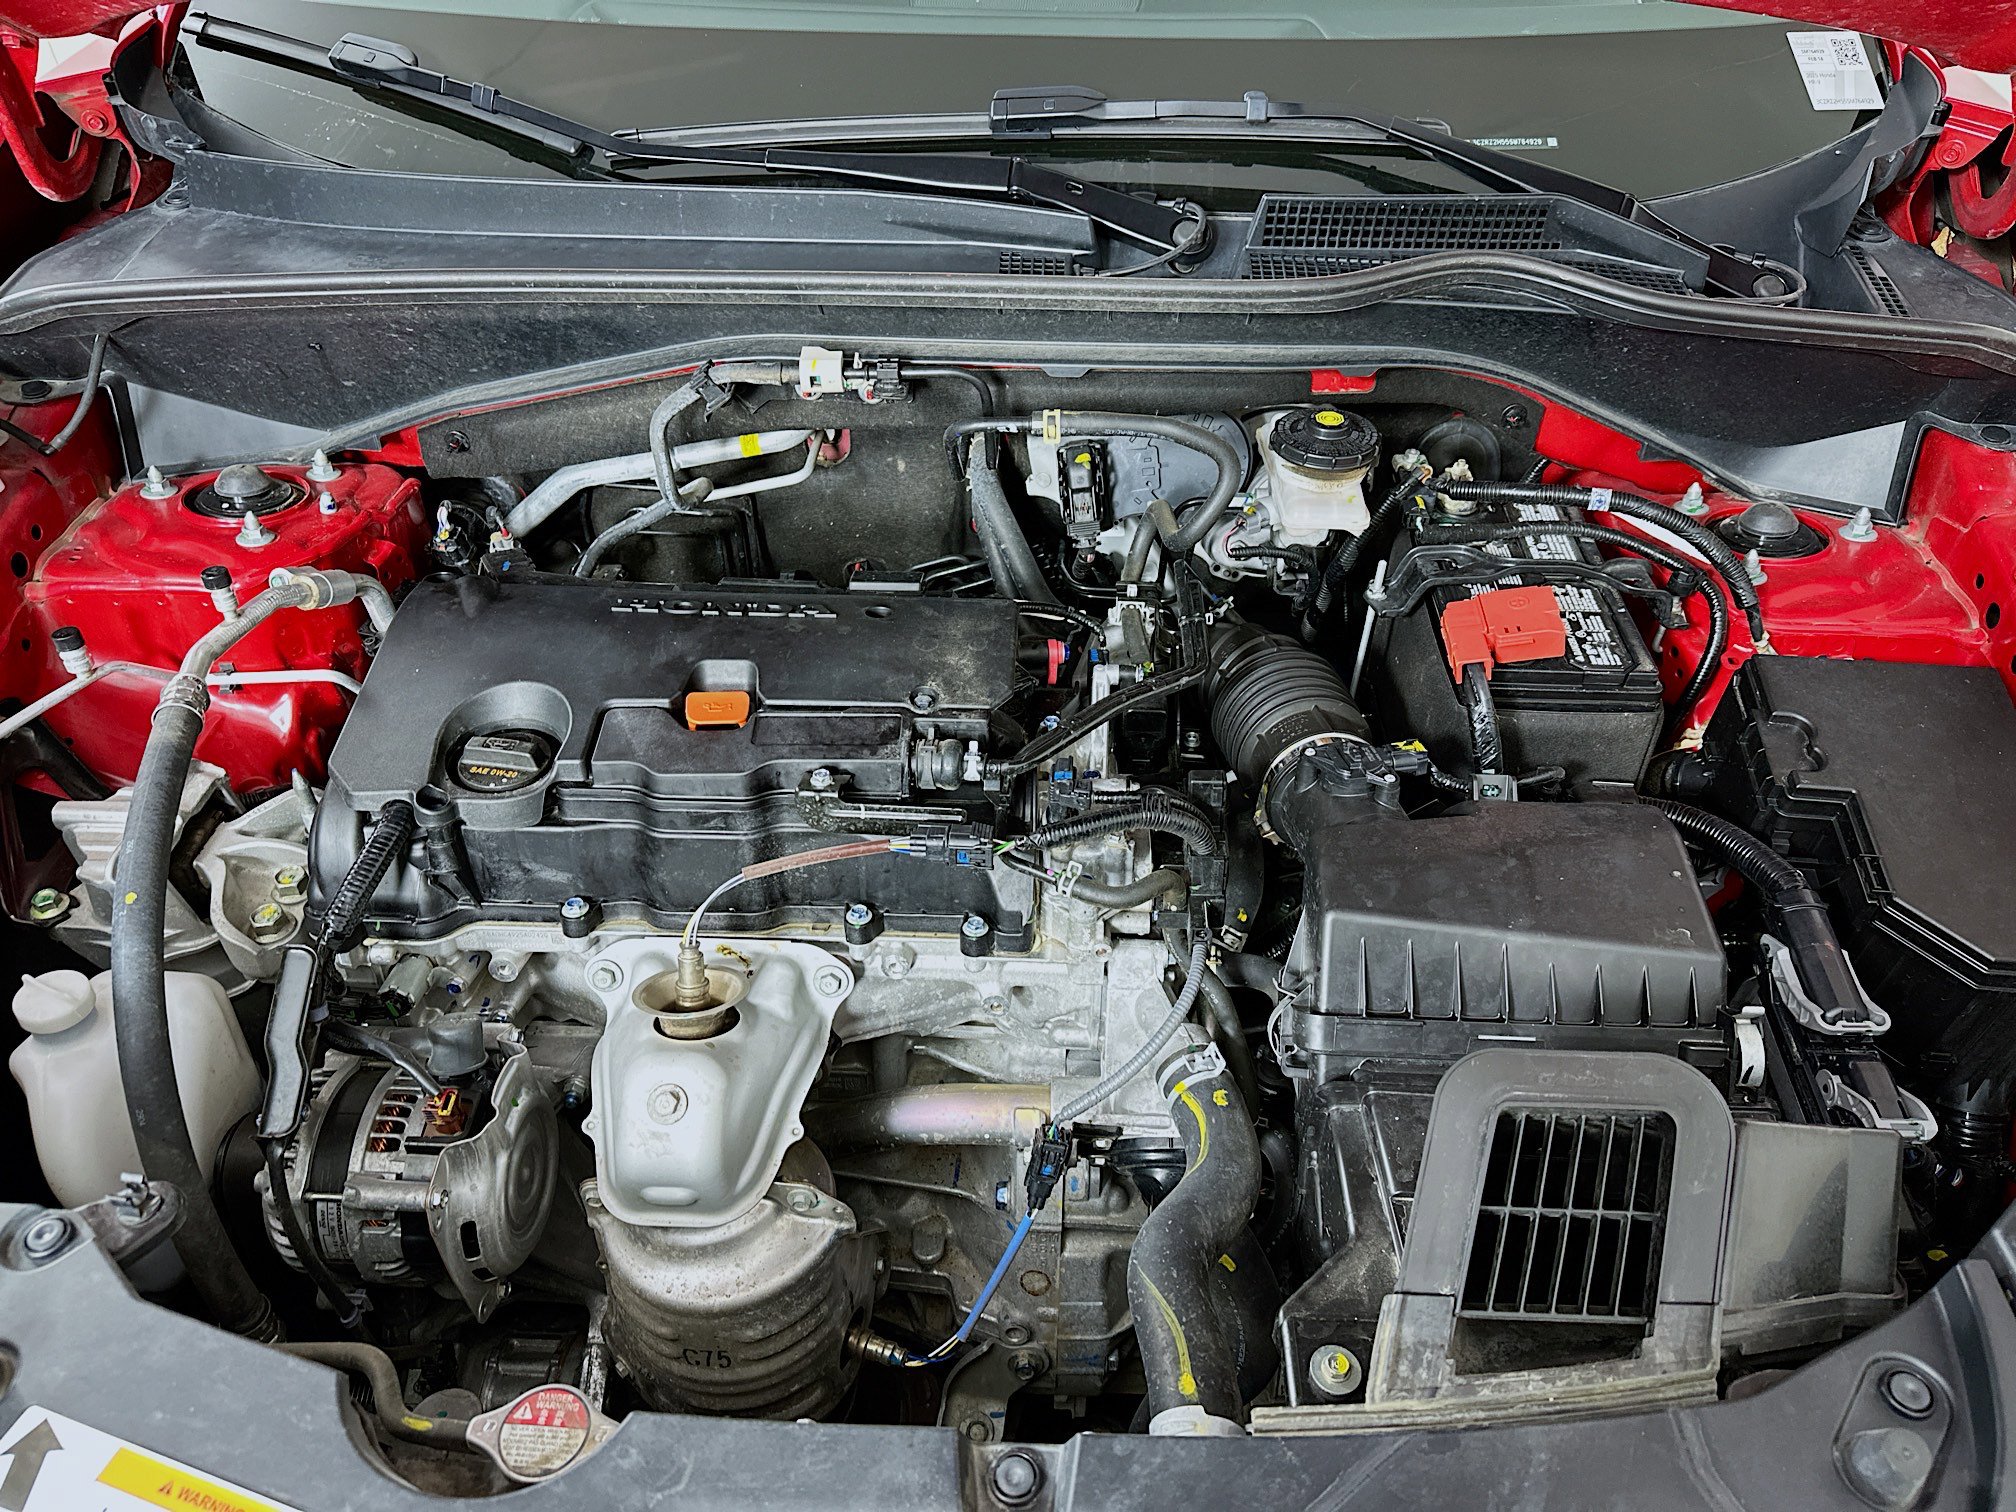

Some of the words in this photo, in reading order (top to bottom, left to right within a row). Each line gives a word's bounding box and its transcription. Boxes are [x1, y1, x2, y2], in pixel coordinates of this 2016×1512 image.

[610, 597, 837, 619] HONDA
[469, 766, 490, 775] SAE
[490, 767, 518, 778] 0W-20
[538, 1392, 574, 1403] DANGER
[536, 1400, 580, 1412] WARNING
